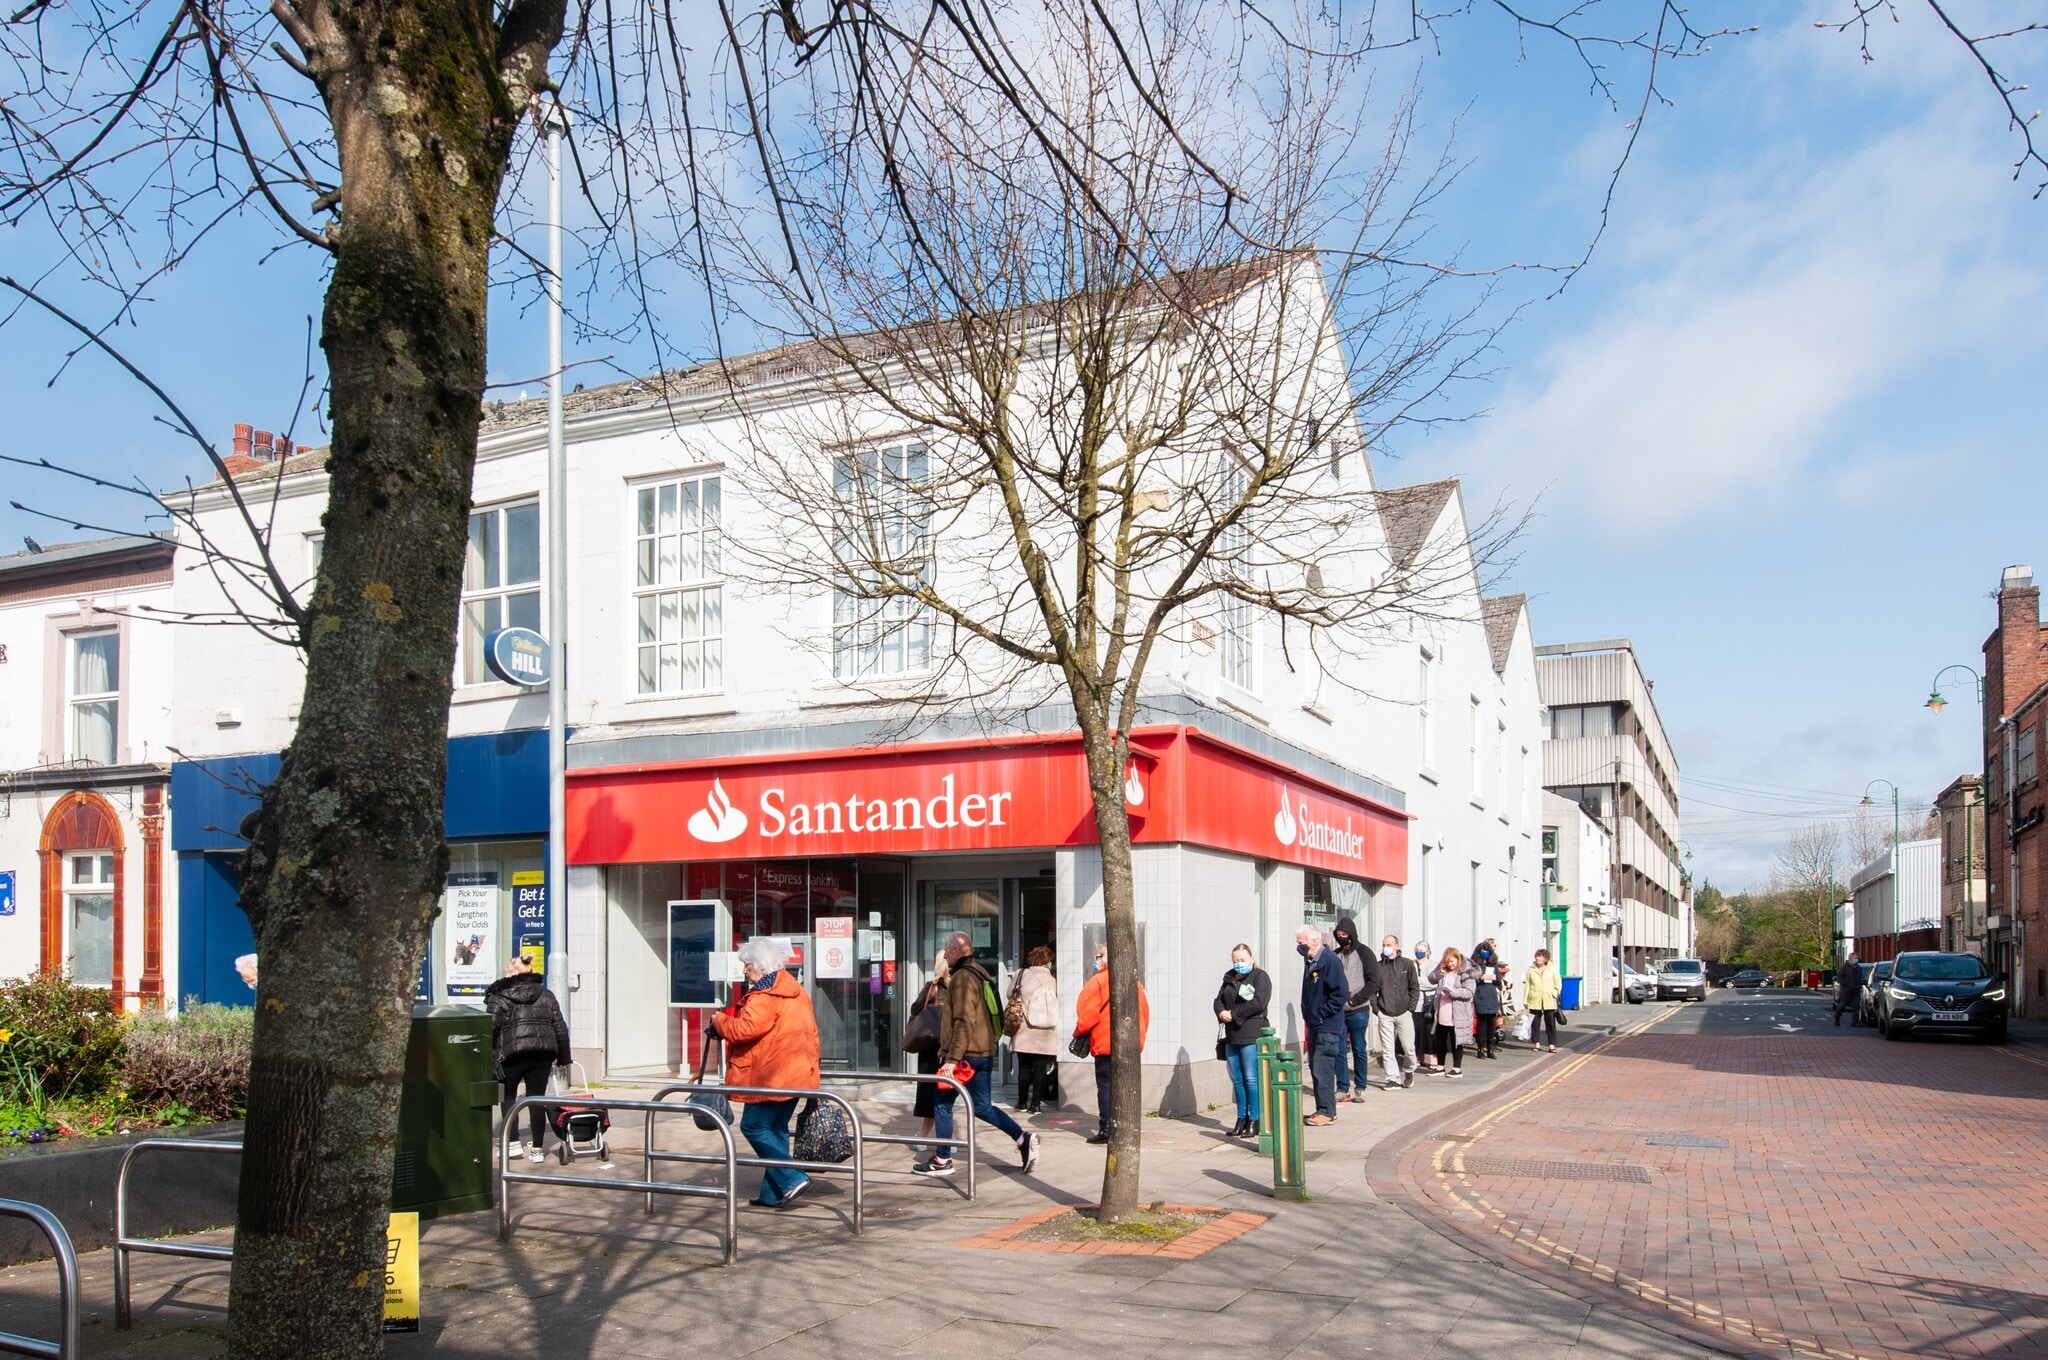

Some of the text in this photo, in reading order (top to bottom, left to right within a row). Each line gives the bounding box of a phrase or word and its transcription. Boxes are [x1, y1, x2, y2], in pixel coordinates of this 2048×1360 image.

[511, 650, 543, 676] HILL
[759, 772, 1012, 837] Santander
[1299, 803, 1364, 860] Santander
[767, 869, 840, 891] Express anking
[472, 889, 488, 897] Your
[519, 888, 538, 902] Bet
[458, 900, 479, 908] Places
[518, 904, 537, 918] Get
[457, 911, 488, 920] Lengthen
[456, 920, 489, 929] Your Odds
[823, 919, 845, 929] STOP
